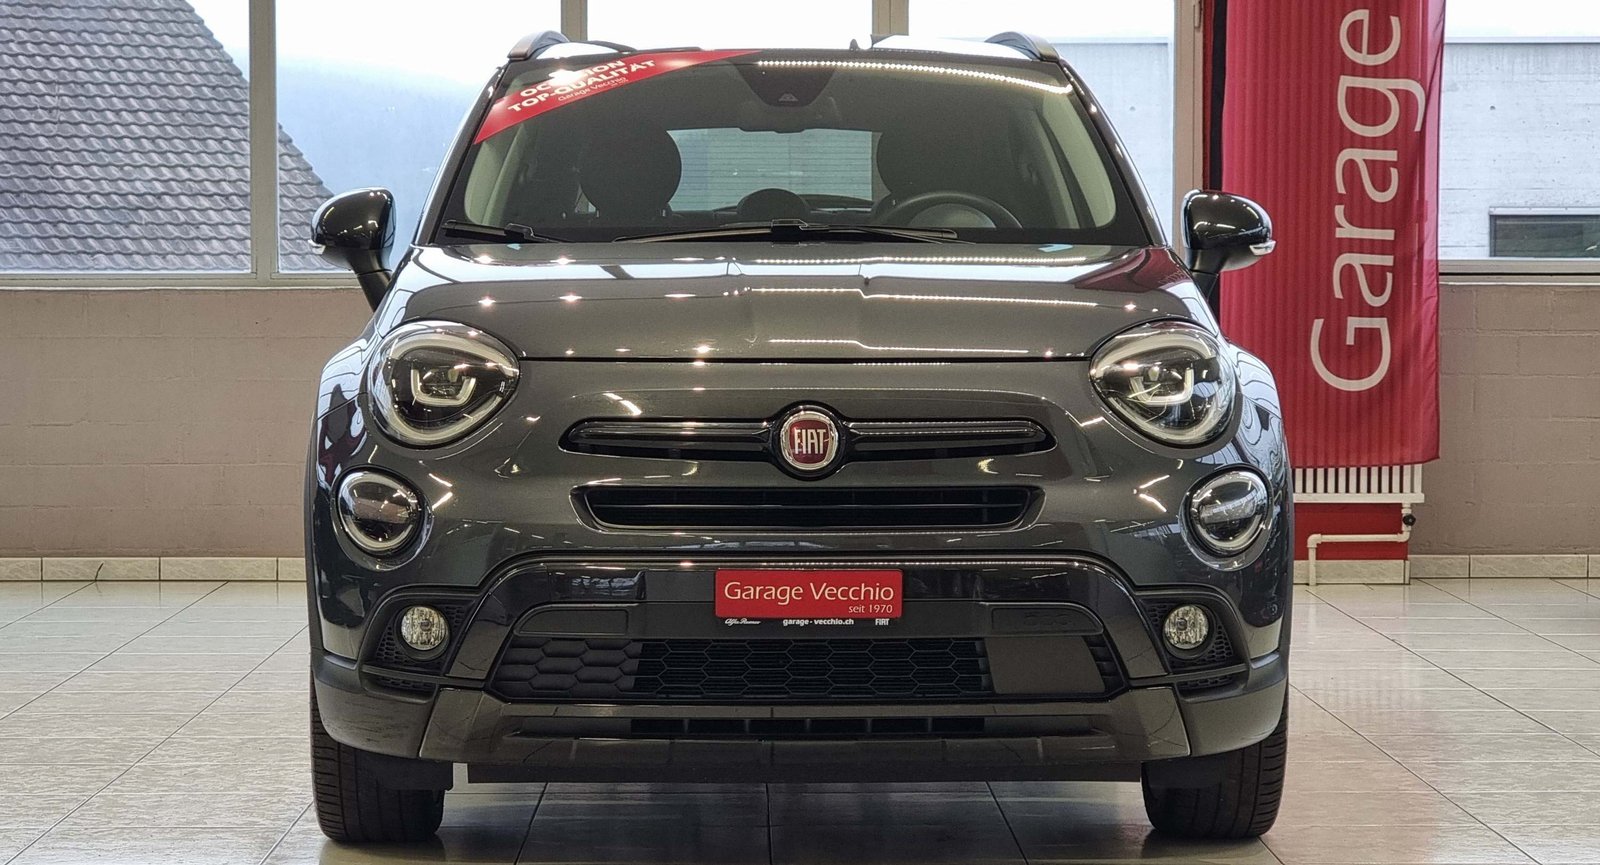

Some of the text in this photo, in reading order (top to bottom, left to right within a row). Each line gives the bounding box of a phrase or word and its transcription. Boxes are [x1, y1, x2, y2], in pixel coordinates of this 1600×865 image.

[507, 60, 656, 112] TOP-QUALITÄT
[520, 60, 626, 98] OCION
[557, 86, 591, 102] Garage
[591, 77, 627, 91] Vecchio
[1310, 9, 1426, 392] Garage
[794, 428, 826, 455] FIAT
[724, 581, 894, 606] Garage Vecchio
[848, 604, 893, 613] seit 1970
[782, 619, 809, 627] garage
[875, 618, 889, 626] FIAT
